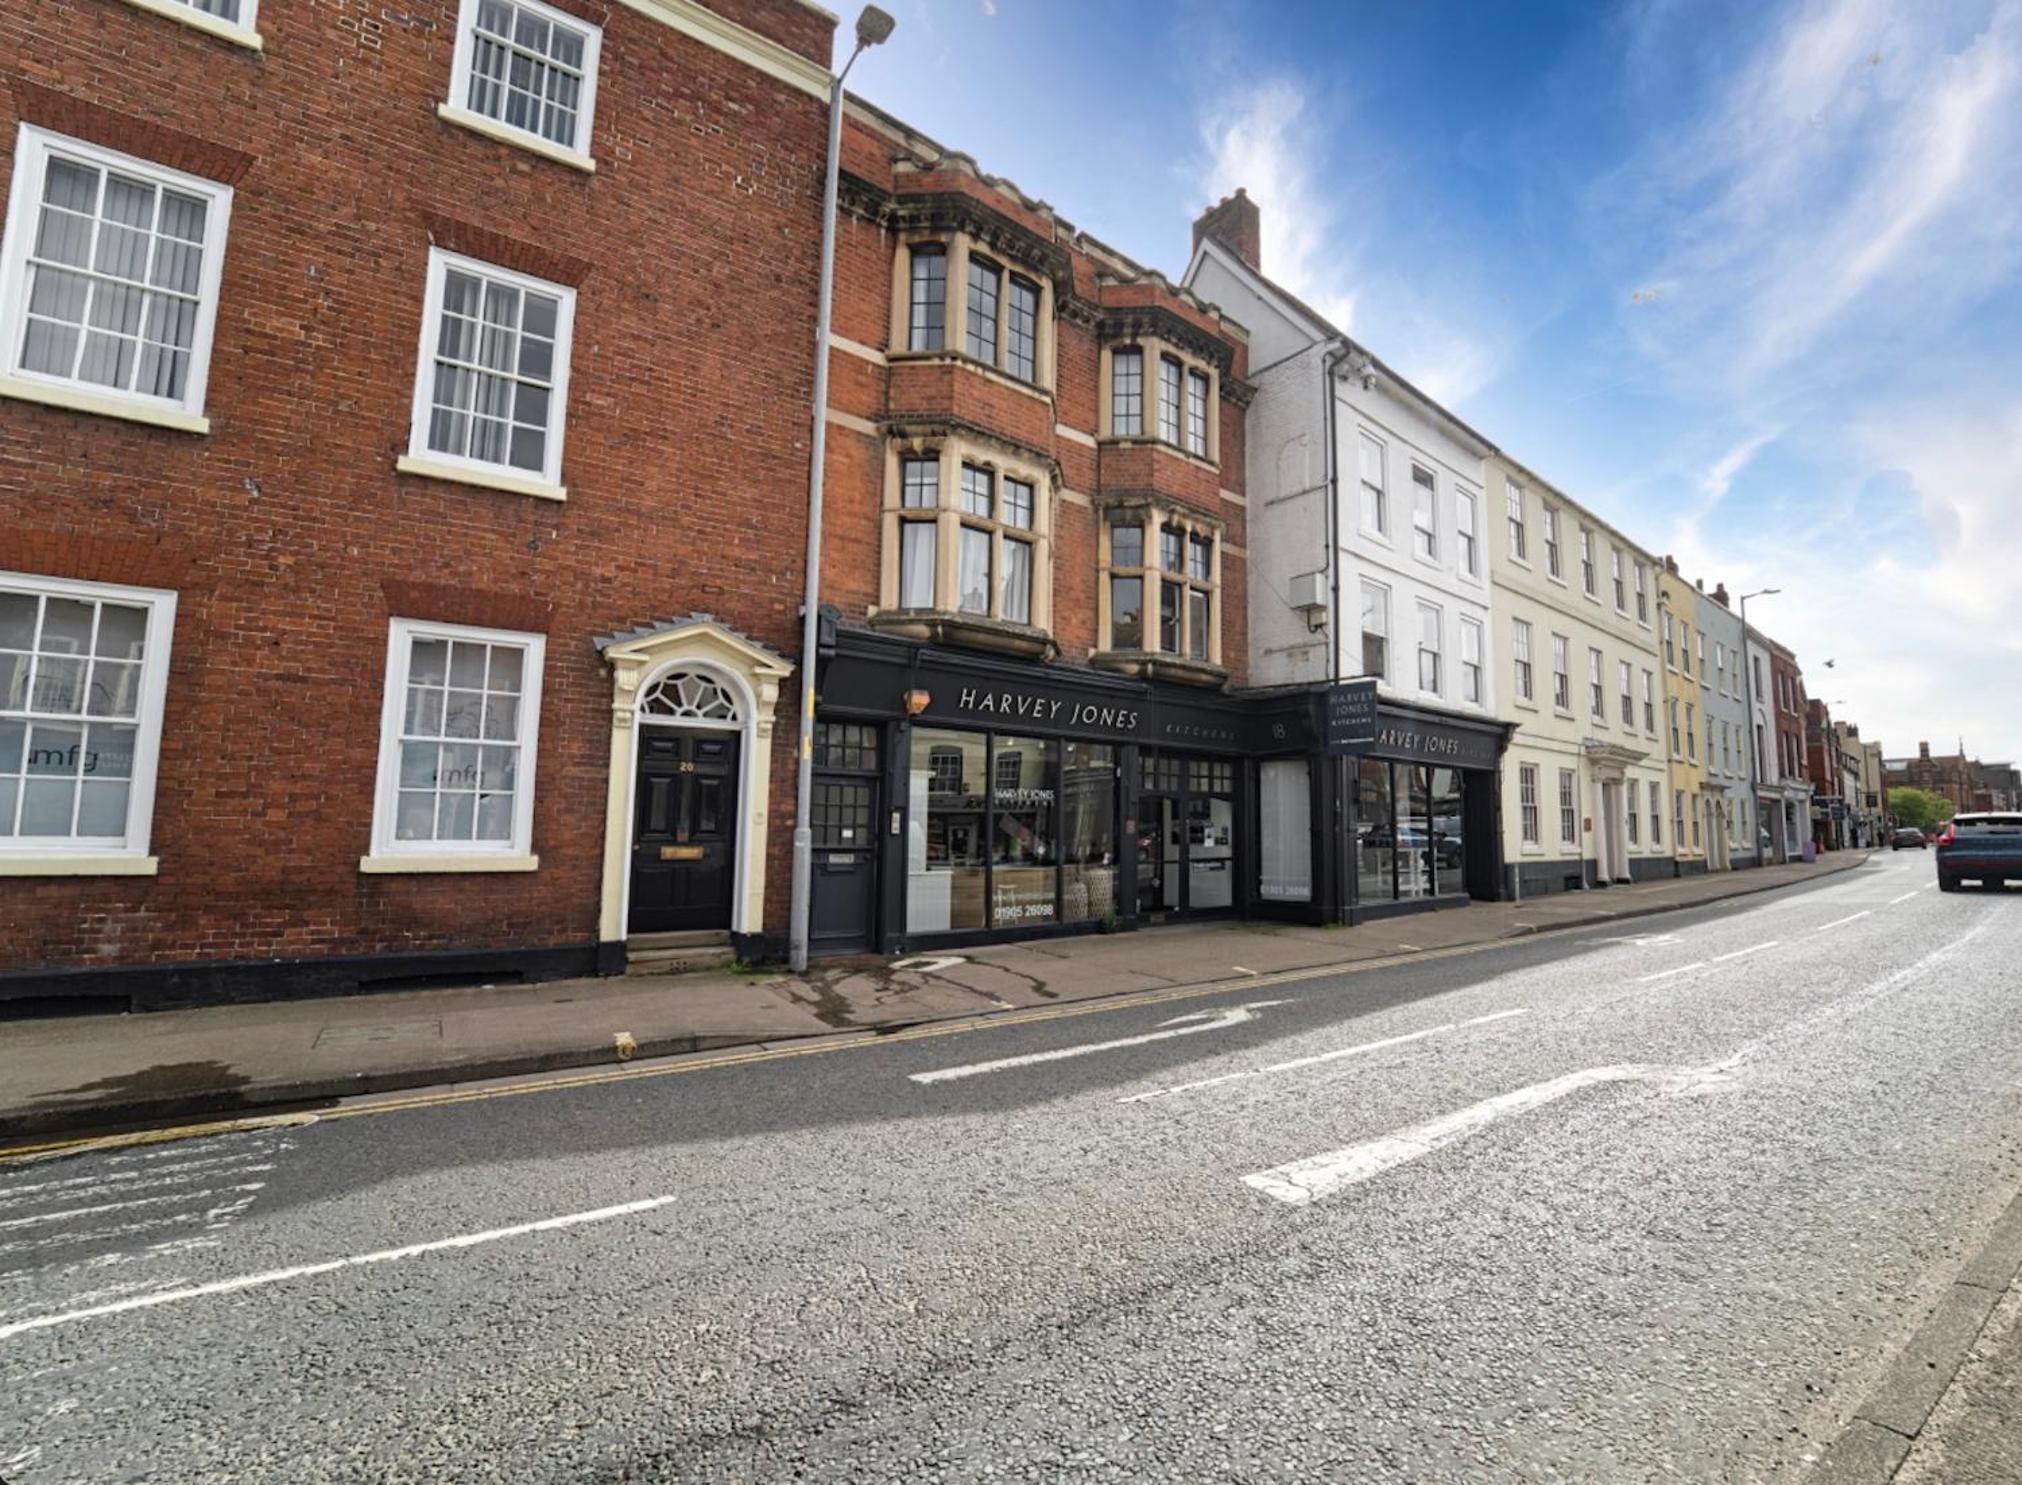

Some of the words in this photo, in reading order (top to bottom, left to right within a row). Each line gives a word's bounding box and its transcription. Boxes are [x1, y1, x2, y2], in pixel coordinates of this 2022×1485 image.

[1329, 691, 1373, 704] HARVEY
[959, 688, 1061, 719] HARVEY
[1069, 703, 1138, 729] JONES
[1336, 703, 1369, 716] JONES
[1379, 729, 1420, 749] ARVEY
[1423, 735, 1458, 754] JONES
[680, 761, 694, 772] 20
